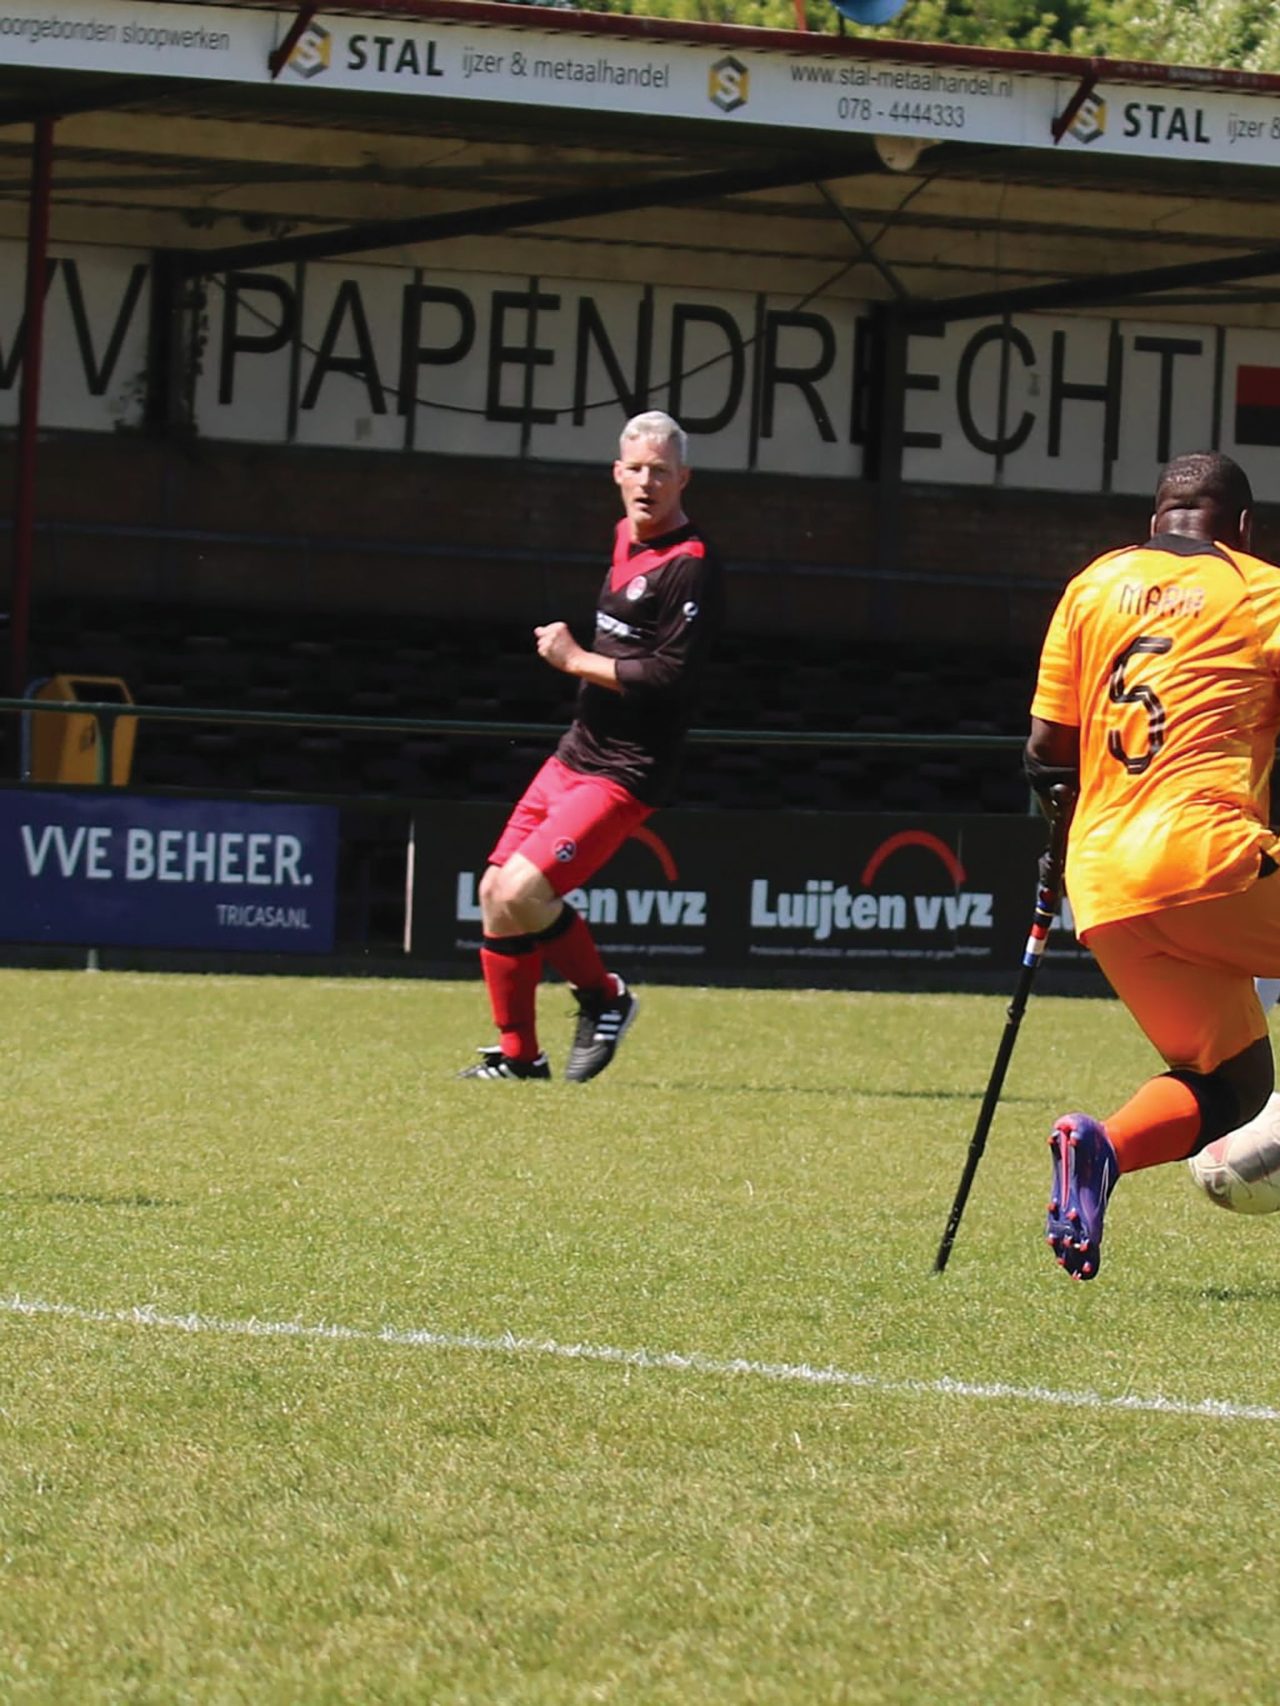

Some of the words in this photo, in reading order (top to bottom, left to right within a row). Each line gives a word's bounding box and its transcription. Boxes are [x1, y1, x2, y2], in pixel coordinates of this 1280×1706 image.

[123, 21, 230, 51] sloopwerken
[347, 34, 443, 77] STAL
[462, 47, 503, 78] ijzer
[510, 52, 528, 77] &
[533, 56, 670, 88] metaalhandel
[791, 62, 1014, 98] www.stal-metaalhandel.nl
[837, 97, 872, 122] 078
[888, 102, 966, 128] 4444333
[1123, 102, 1210, 144] STAL
[1226, 112, 1265, 145] ijzer
[219, 271, 1204, 465] PAPENDRECHT
[1107, 635, 1174, 776] 5
[21, 825, 113, 880] VVE
[125, 828, 313, 886] BEHEER.
[625, 888, 707, 927] vvz
[750, 878, 907, 940] Luijten
[913, 891, 994, 931] vvz
